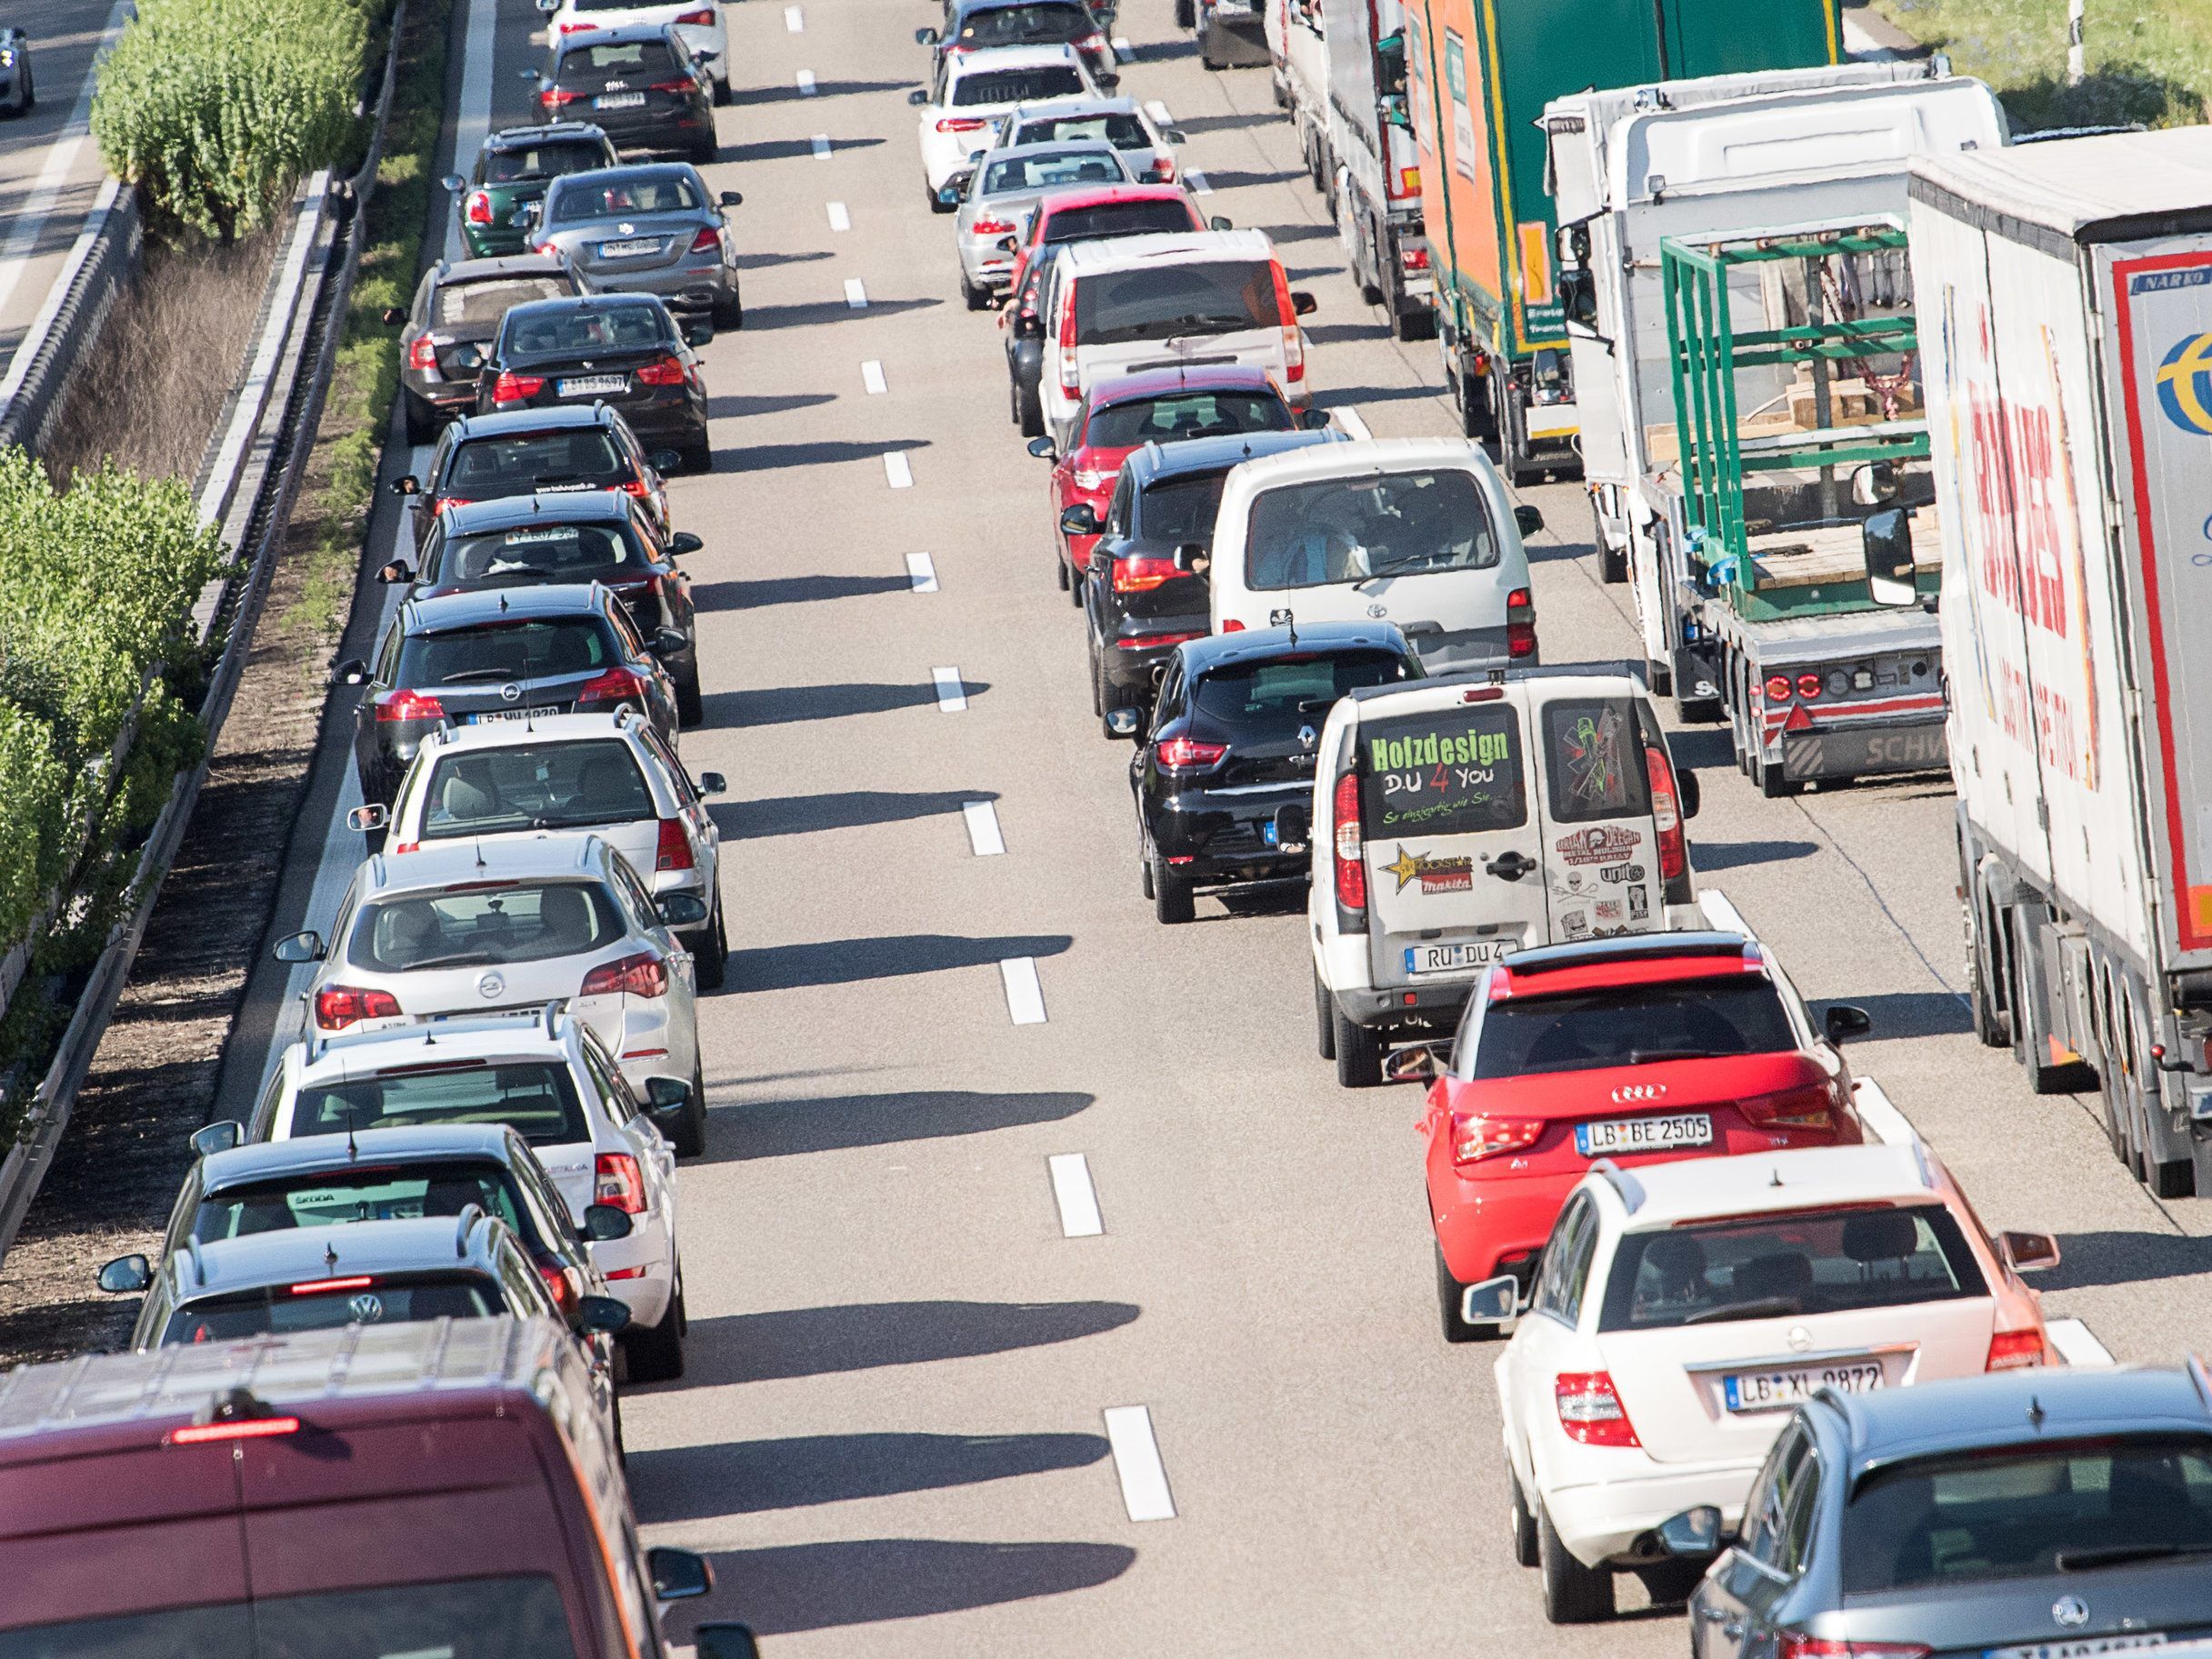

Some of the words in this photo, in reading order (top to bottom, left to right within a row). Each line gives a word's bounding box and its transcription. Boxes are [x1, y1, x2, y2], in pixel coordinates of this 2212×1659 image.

[1371, 729, 1509, 772] Holzdesign
[1429, 762, 1450, 794] 4
[1455, 767, 1495, 789] YOU
[1428, 946, 1453, 968] RU
[1465, 945, 1489, 964] DU
[1493, 944, 1503, 960] 4
[1592, 1123, 1616, 1147] LB
[1631, 1121, 1656, 1143] BE
[1660, 1117, 1709, 1141] 2505
[1743, 1376, 1771, 1402] LB
[1787, 1371, 1813, 1397] XL
